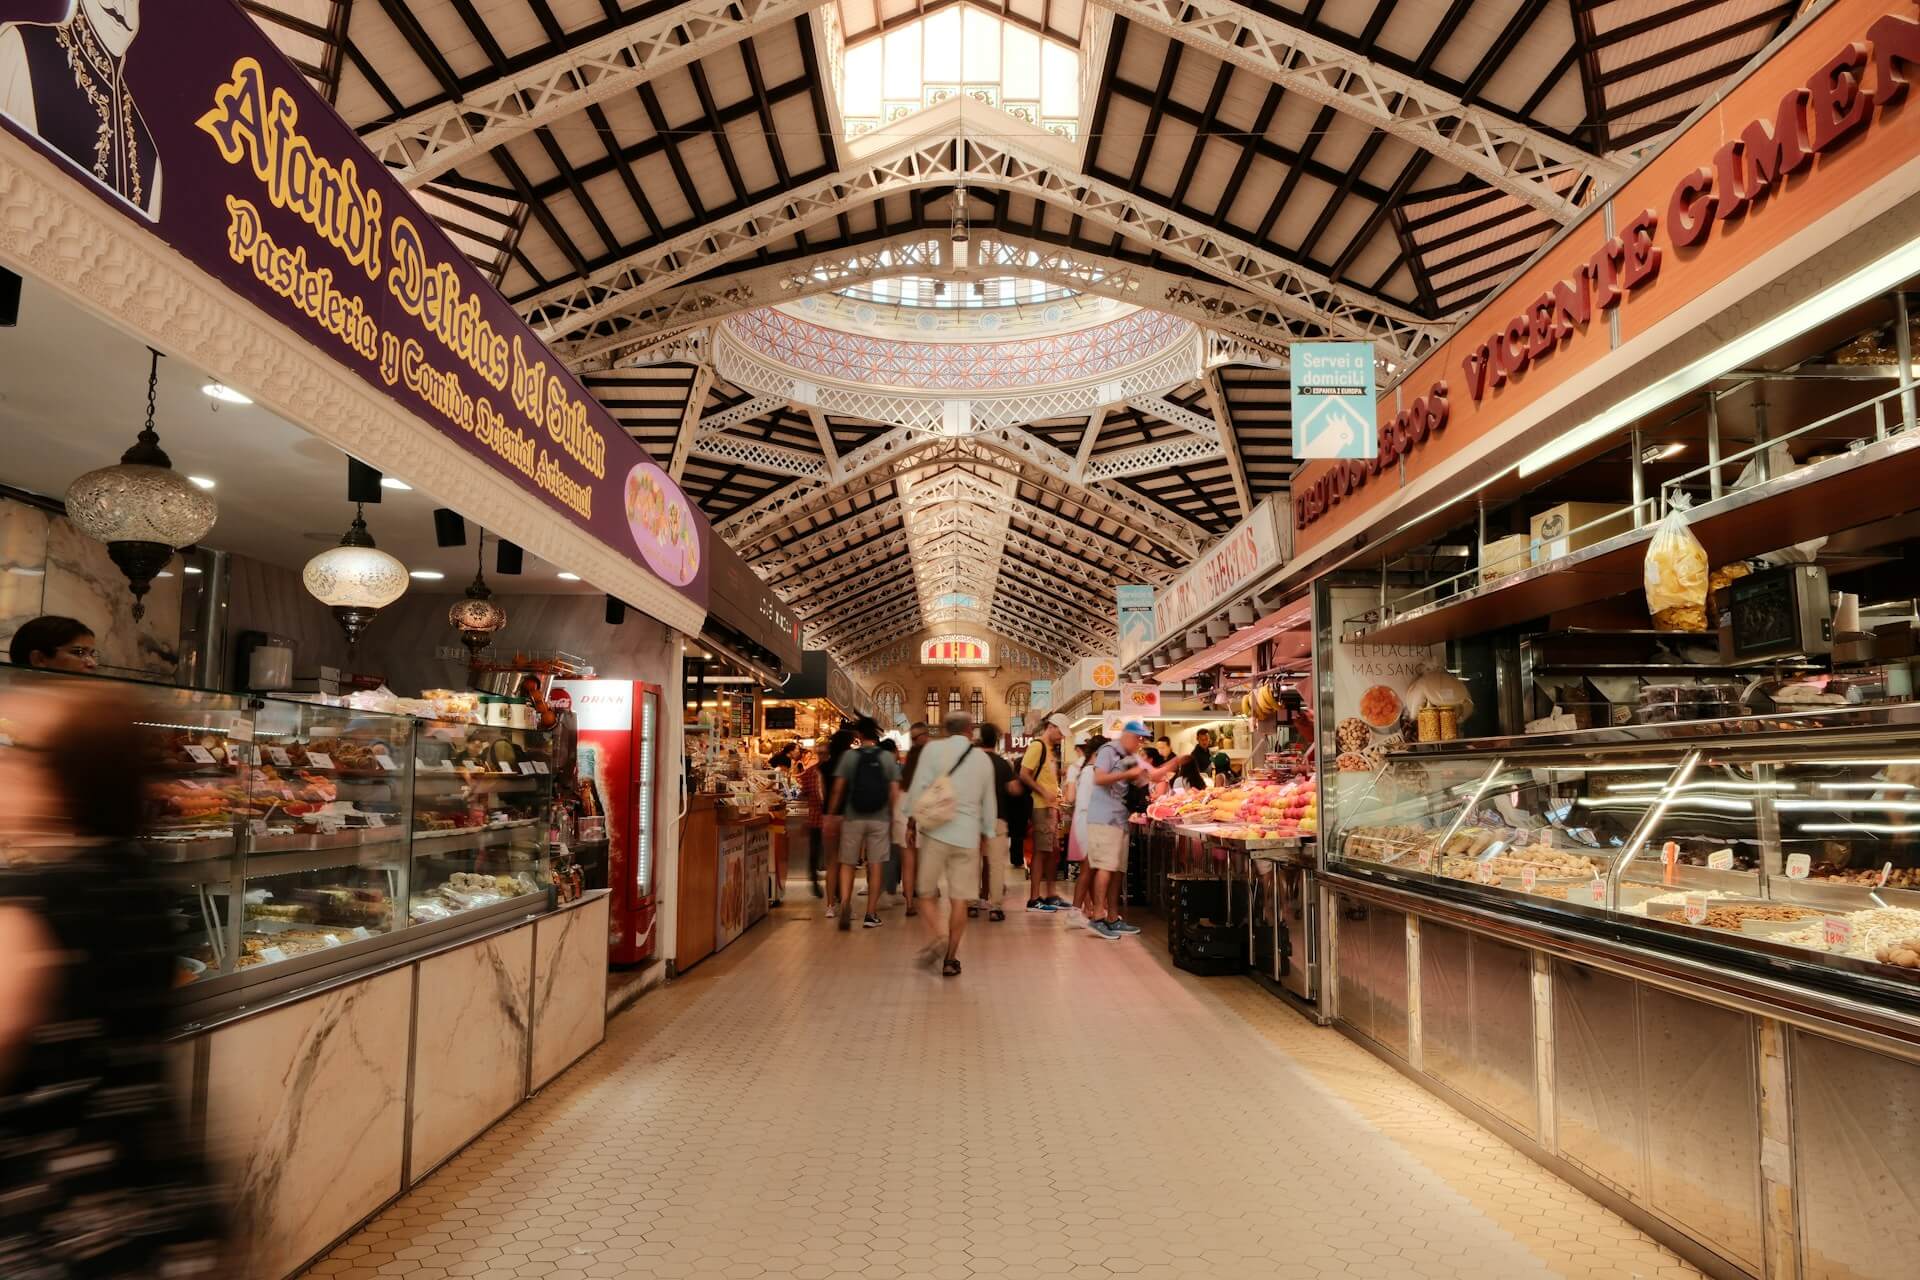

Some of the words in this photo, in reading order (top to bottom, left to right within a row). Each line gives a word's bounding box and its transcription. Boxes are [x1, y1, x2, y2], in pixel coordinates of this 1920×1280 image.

[195, 57, 382, 280] Afandi
[389, 216, 509, 391] Delicias
[512, 335, 545, 427] del
[1462, 208, 1664, 401] VICENTE
[379, 331, 400, 386] y
[402, 338, 474, 432] Comida
[1303, 352, 1350, 368] Servei
[1355, 356, 1364, 368] a
[1303, 370, 1364, 385] domicili
